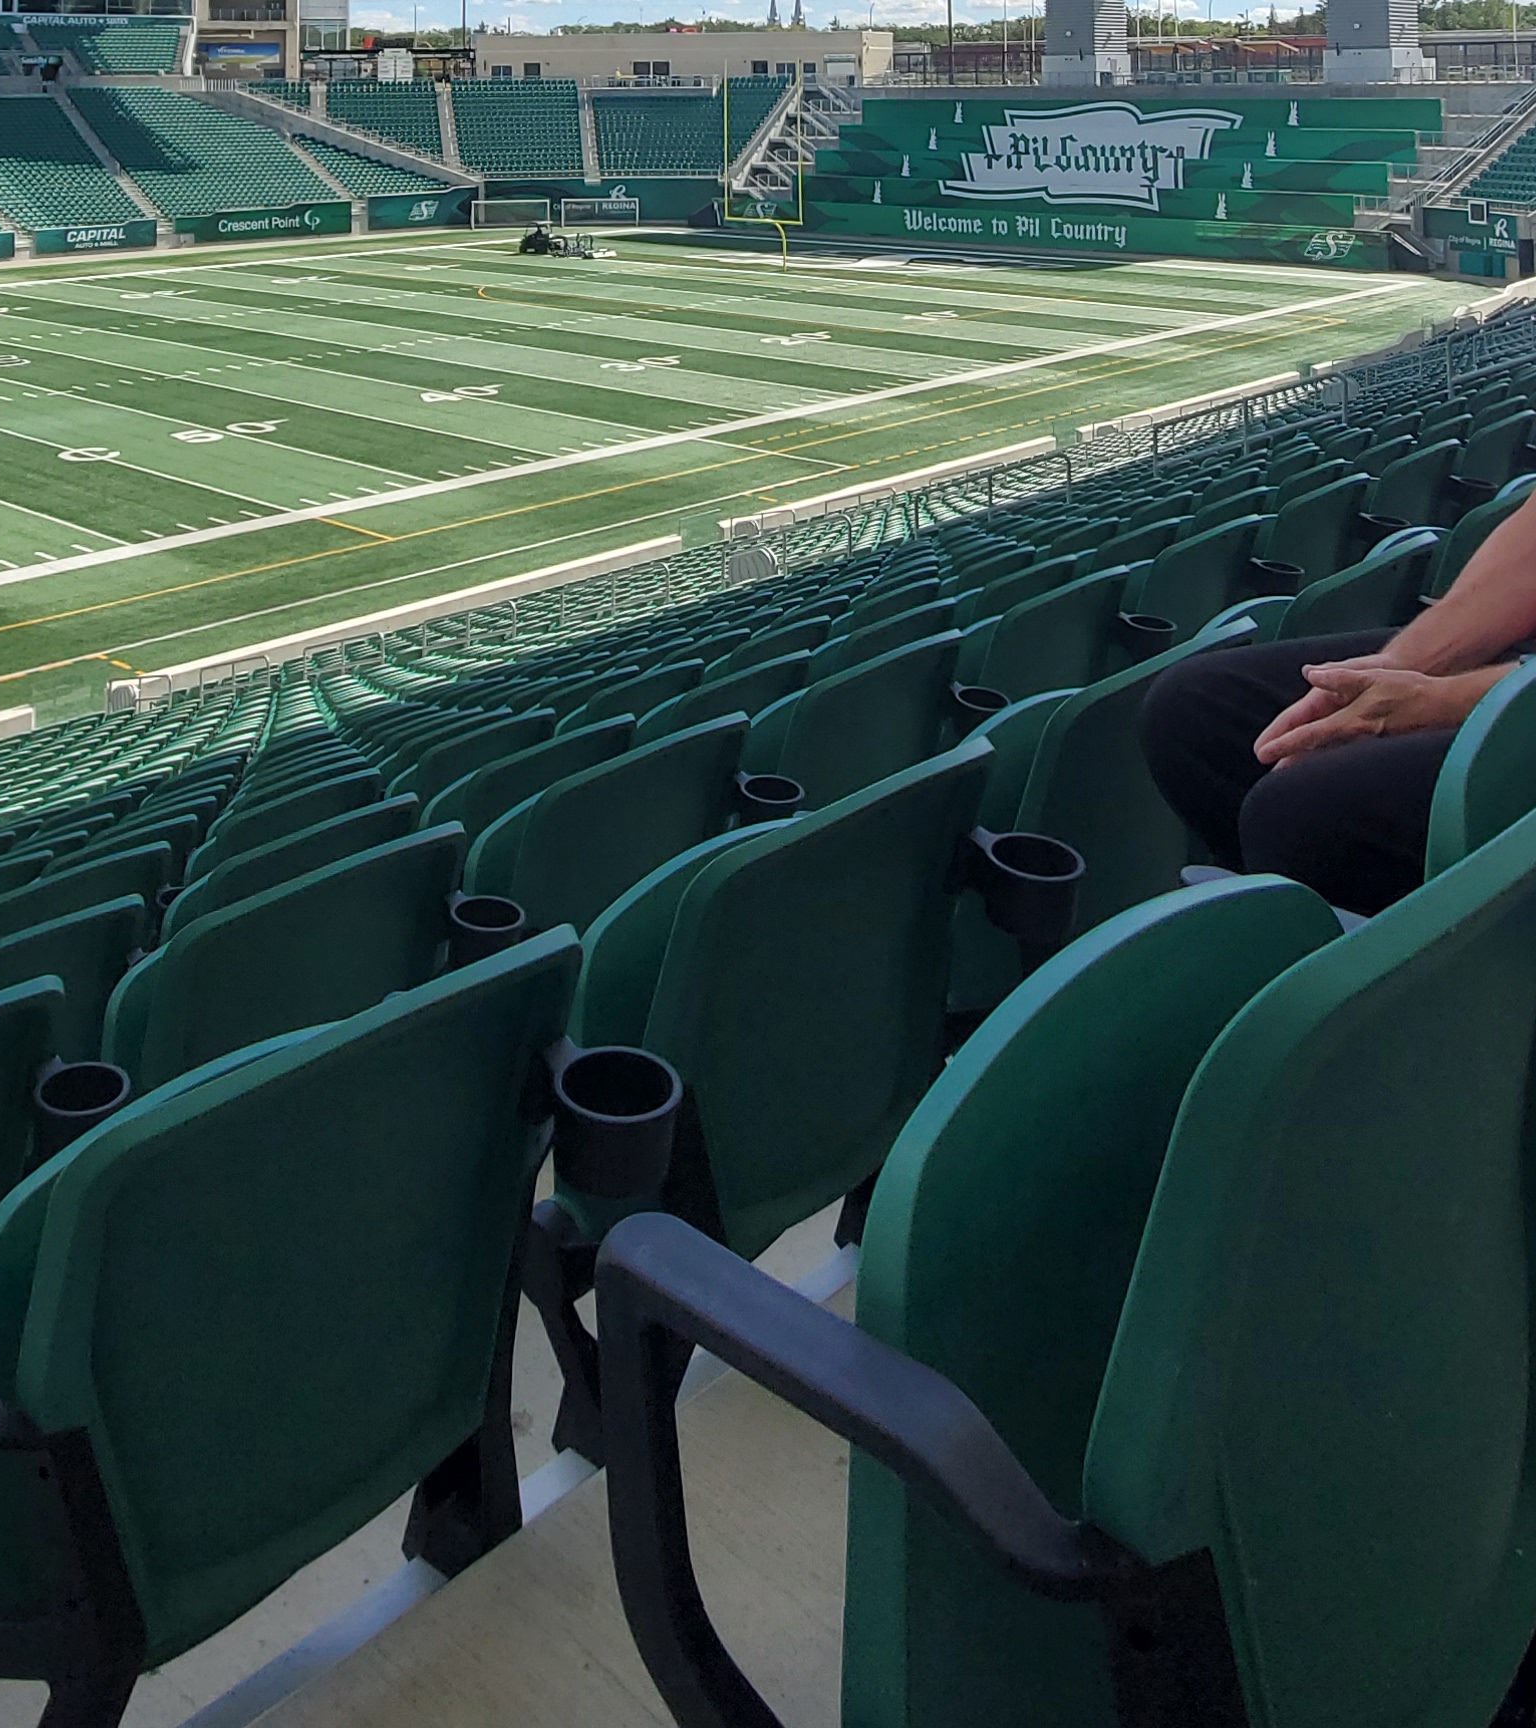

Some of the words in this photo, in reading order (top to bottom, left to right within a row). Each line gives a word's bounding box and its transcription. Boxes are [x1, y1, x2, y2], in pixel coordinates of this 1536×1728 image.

[23, 16, 66, 25] CAPITAL
[68, 17, 97, 26] AUTO
[1004, 133, 1053, 173] Pil
[1054, 135, 1169, 184] Country
[602, 202, 636, 211] REGINA
[218, 218, 269, 232] Crescent
[271, 215, 300, 228] Point
[903, 209, 983, 234] Welcome
[992, 217, 1008, 235] to
[1015, 215, 1040, 237] Pil
[1051, 219, 1127, 248] Country
[66, 228, 126, 243] CAPITAL
[1448, 235, 1460, 245] City
[1489, 238, 1516, 249] REGINA
[419, 385, 500, 404] 40
[169, 422, 277, 444] 50
